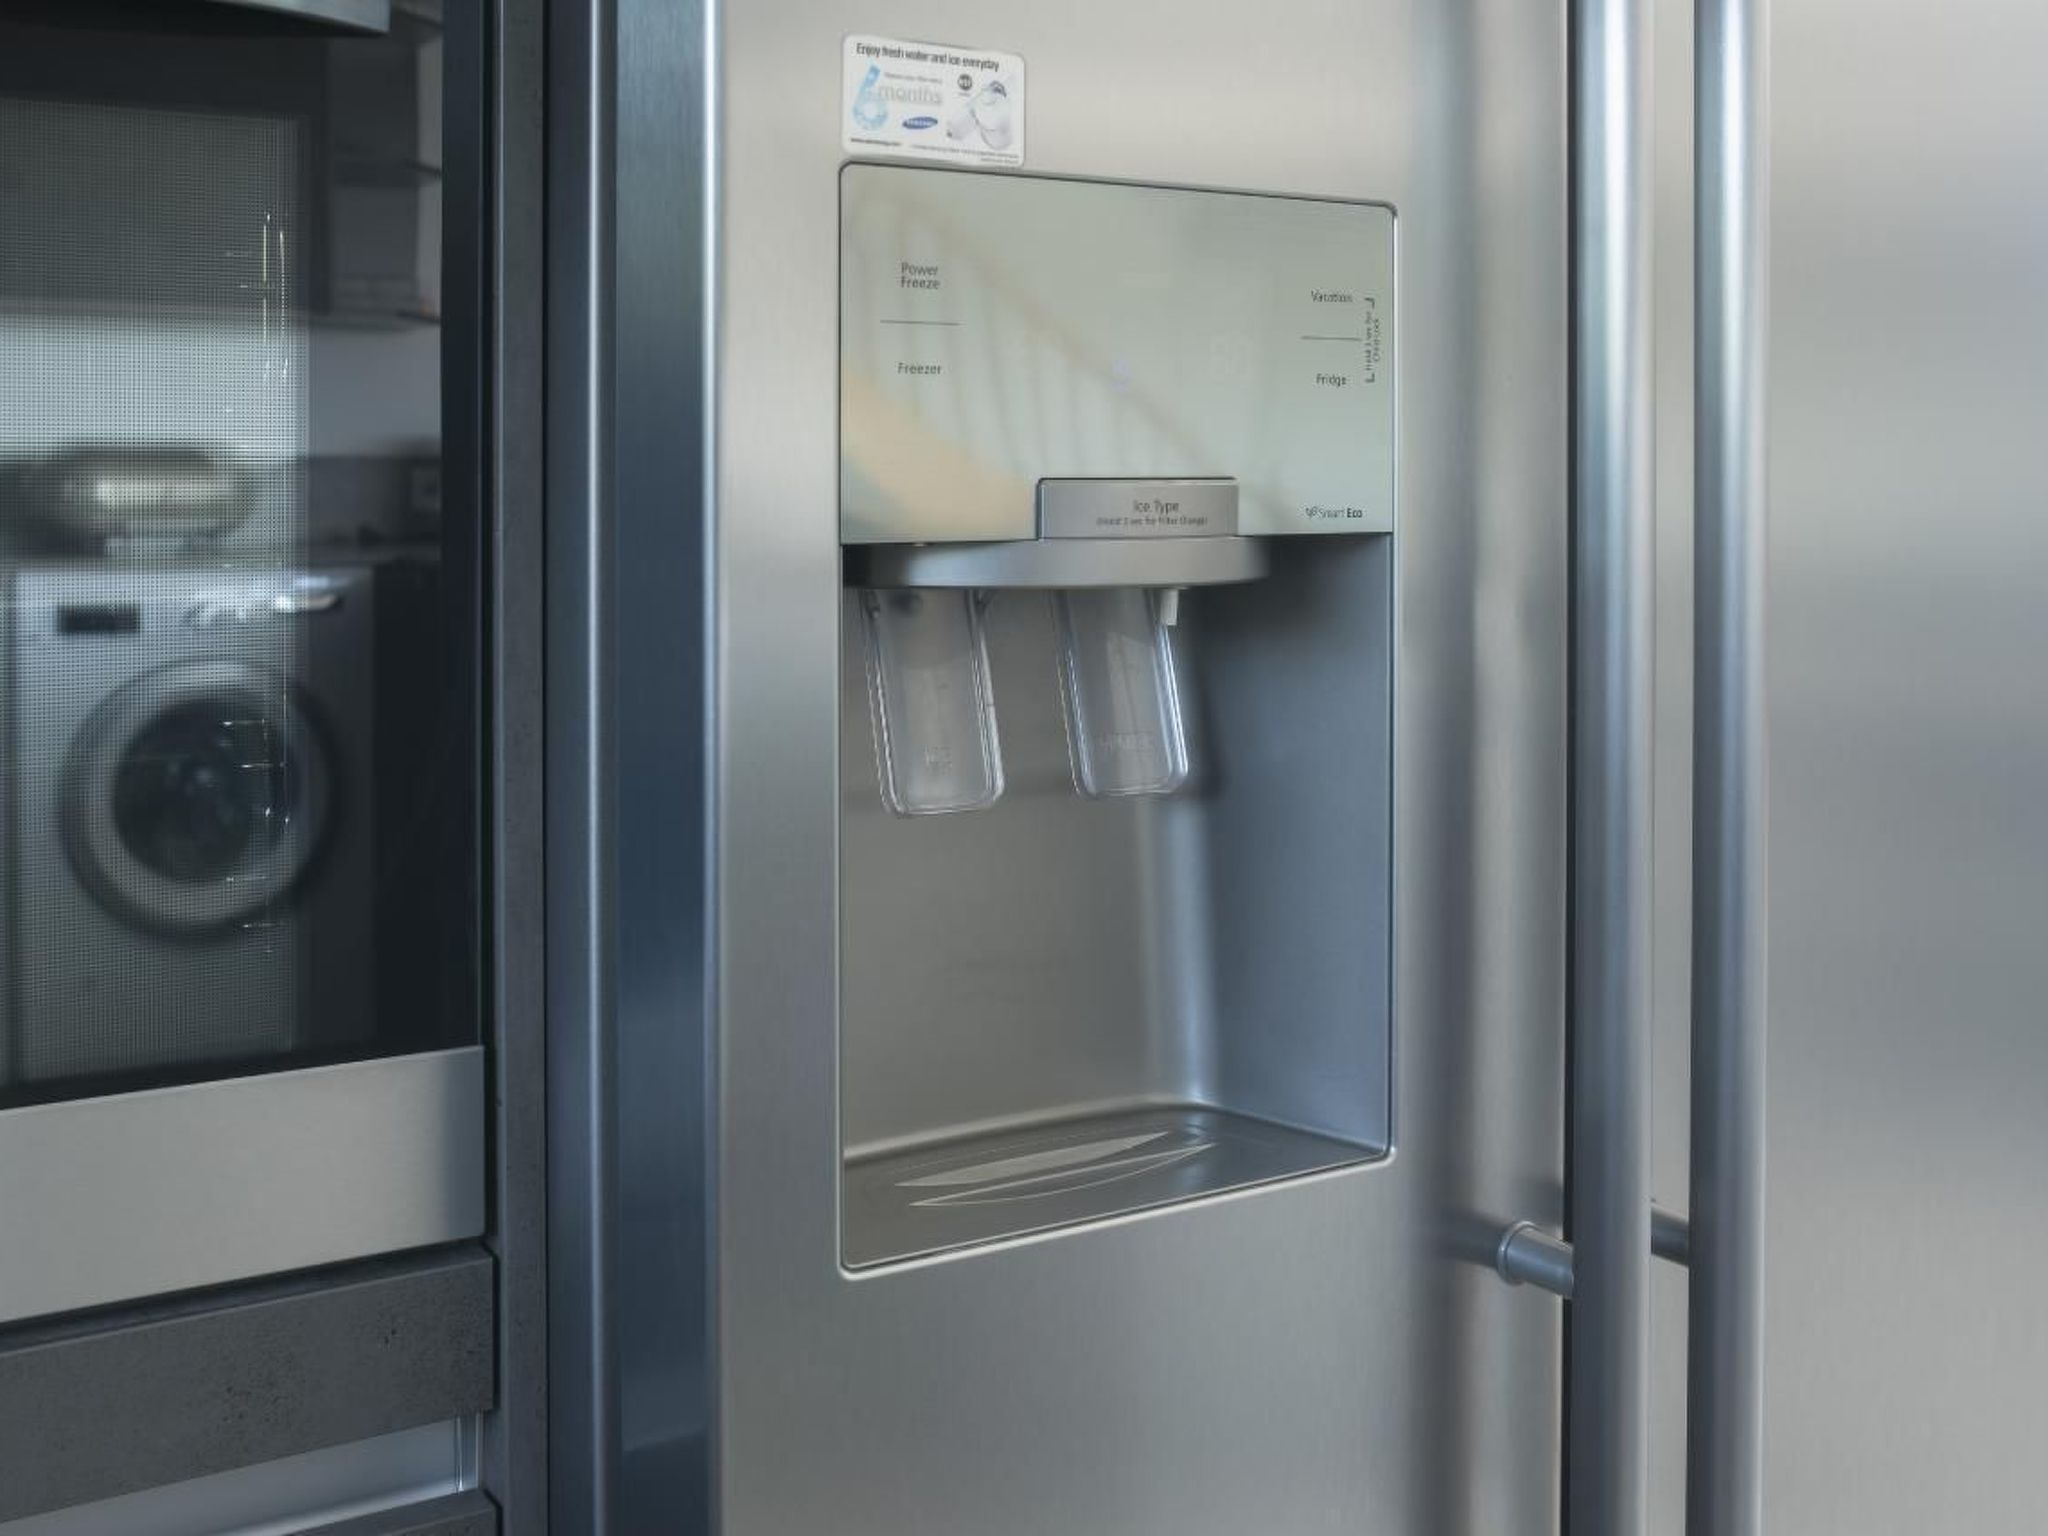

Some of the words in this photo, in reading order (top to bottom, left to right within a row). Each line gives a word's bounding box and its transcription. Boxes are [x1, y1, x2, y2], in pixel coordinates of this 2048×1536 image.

[856, 43, 881, 58] Enjoy
[882, 46, 904, 58] fresh
[931, 53, 948, 64] and
[949, 55, 961, 66] ice
[962, 57, 1000, 72] everyday
[901, 262, 939, 276] Power
[901, 276, 940, 289] Freeze
[898, 362, 942, 375] Freezer
[1316, 373, 1347, 387] Fridge
[1133, 500, 1151, 513] Ice
[1154, 499, 1180, 515] Type
[1346, 507, 1363, 519] Eco
